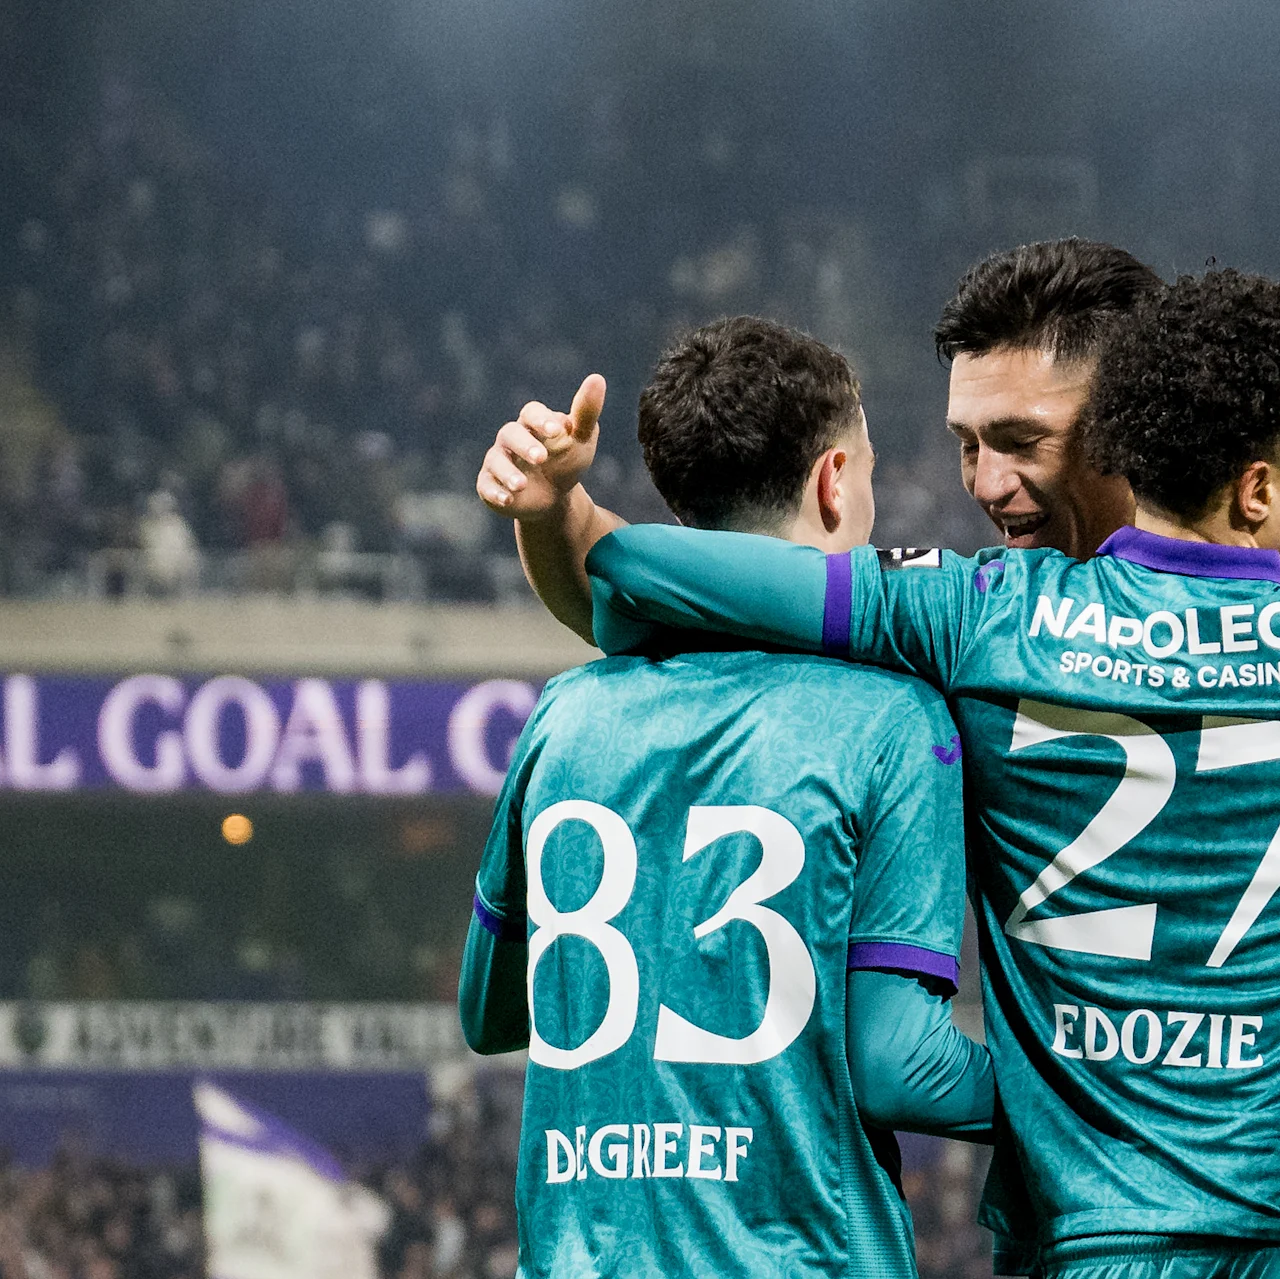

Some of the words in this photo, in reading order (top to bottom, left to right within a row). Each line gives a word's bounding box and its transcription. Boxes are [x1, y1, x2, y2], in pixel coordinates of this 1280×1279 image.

[1059, 650, 1166, 688] SPORTS
[1170, 667, 1192, 689] &
[96, 674, 434, 796] GOAL
[525, 799, 817, 1071] 83
[1051, 1003, 1265, 1069] EDOZIE
